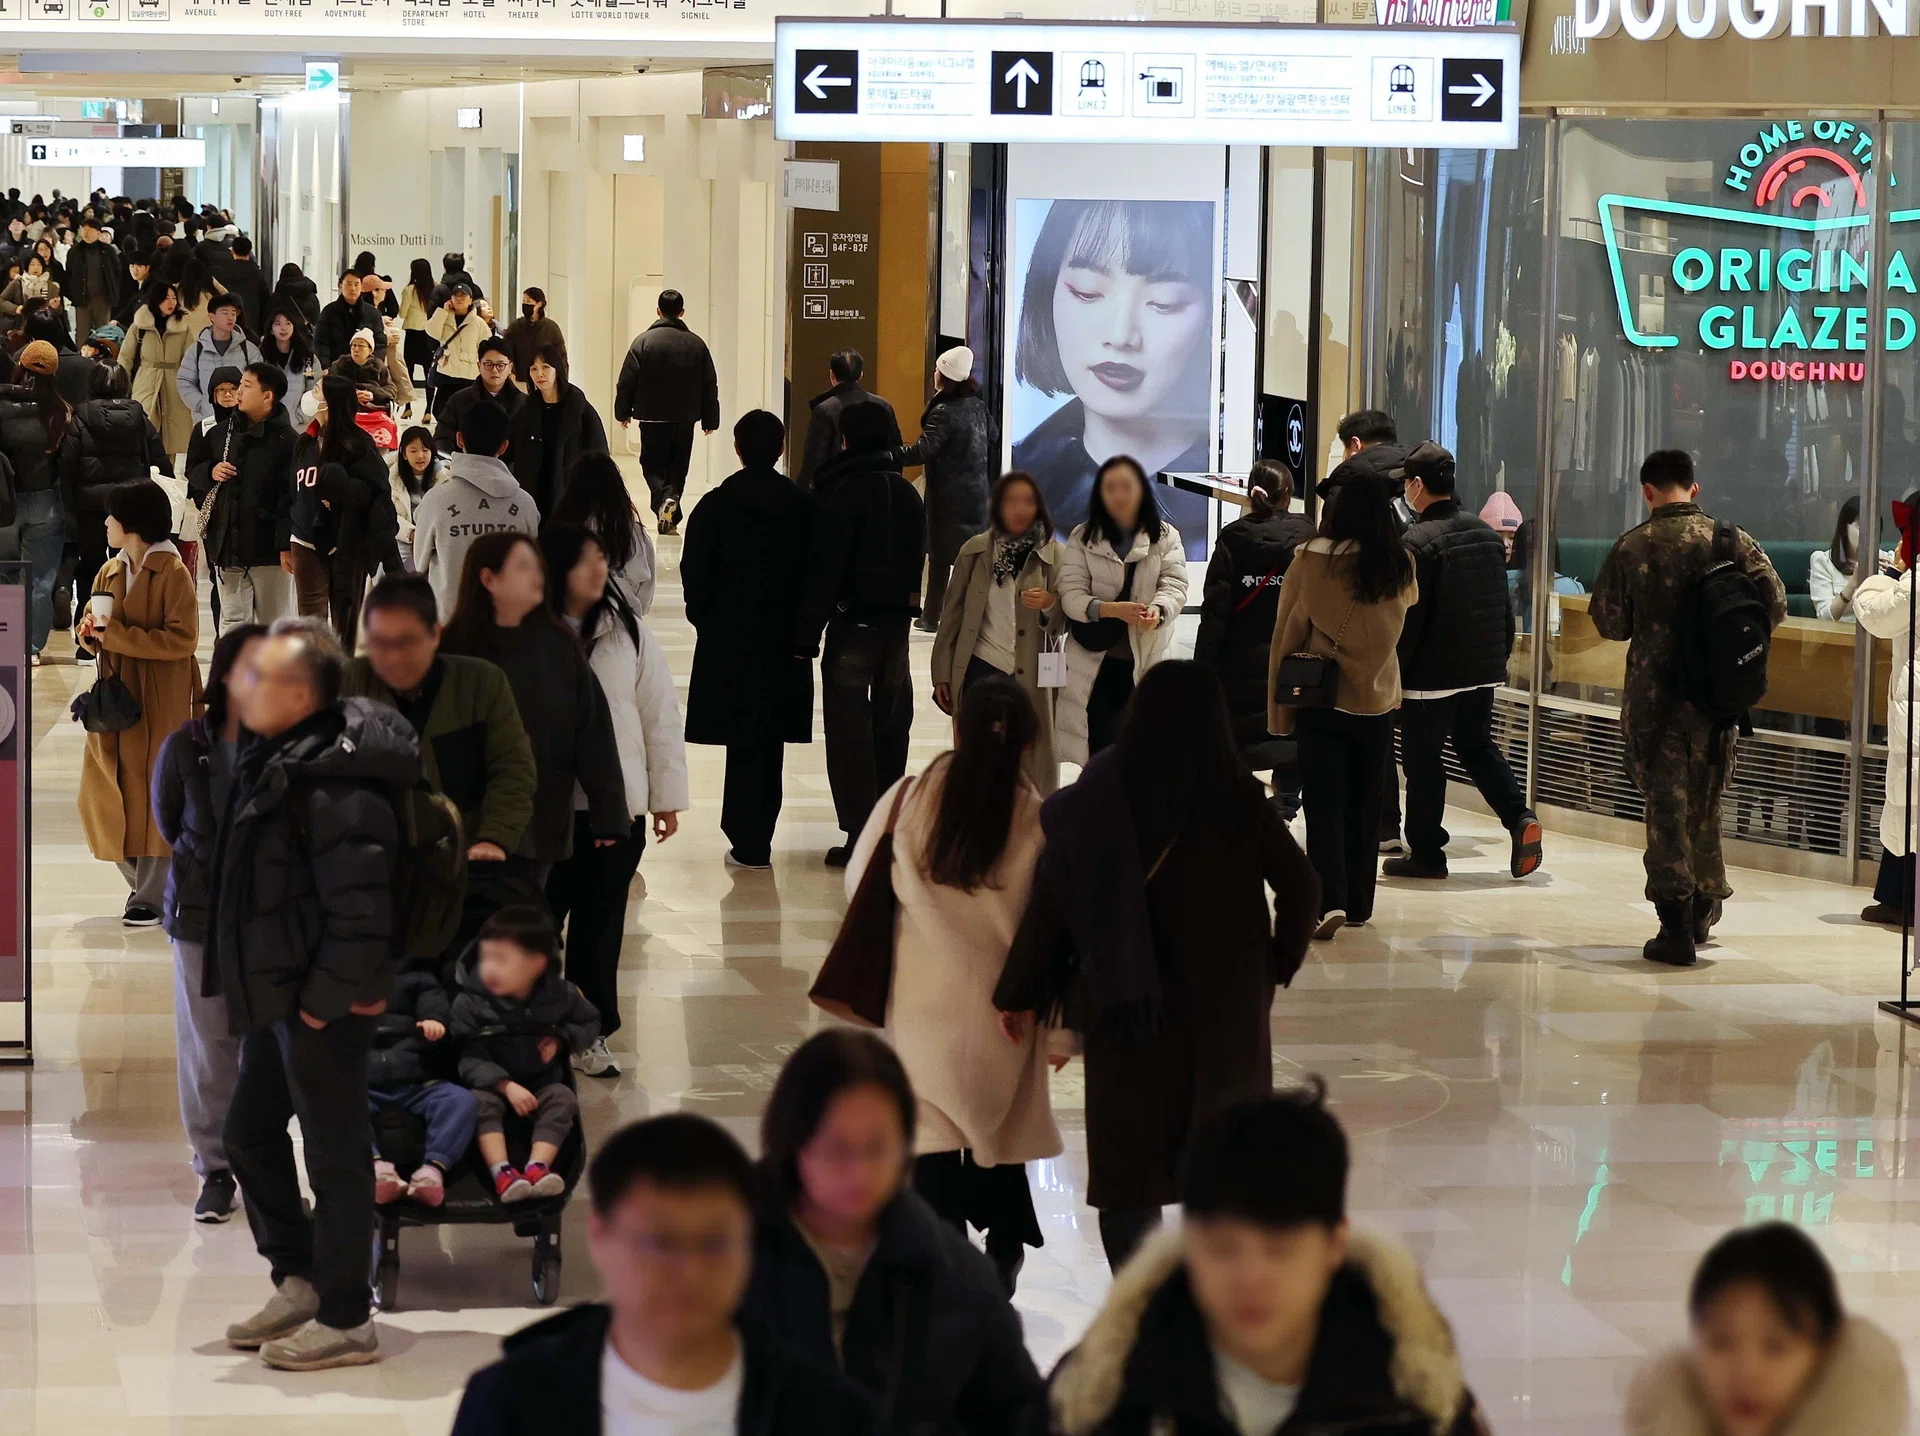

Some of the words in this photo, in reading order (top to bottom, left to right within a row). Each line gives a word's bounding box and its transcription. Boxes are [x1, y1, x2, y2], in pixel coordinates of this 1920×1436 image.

[184, 8, 218, 17] AVENUEL
[264, 9, 283, 18] DUTY
[285, 10, 303, 18] FREE
[324, 10, 367, 18] ADVENTURE
[402, 10, 449, 18] DEPARTMENT
[463, 10, 487, 19] HOTEL
[507, 11, 540, 19] THEATER
[571, 11, 595, 20] LOTTE
[596, 11, 623, 20] WORLD
[624, 12, 650, 20] TOWER
[681, 12, 711, 20] SIGNIEL
[402, 18, 425, 27] STORE
[937, 57, 975, 70] 시그니엘
[867, 87, 933, 100] 롯데월드타워
[1078, 100, 1099, 111] LINE
[1101, 100, 1107, 110] 2
[1388, 104, 1408, 115] LINE
[1724, 120, 1806, 192] HOME
[1813, 120, 1856, 145] OF
[350, 233, 395, 246] Massimo
[400, 233, 427, 246] Dutti
[831, 233, 869, 243] 주차장연결
[1671, 247, 1917, 293] ORIGINA
[1698, 305, 1917, 351] GLAZED
[1730, 360, 1865, 382] DOUGHNU
[296, 466, 318, 492] PO
